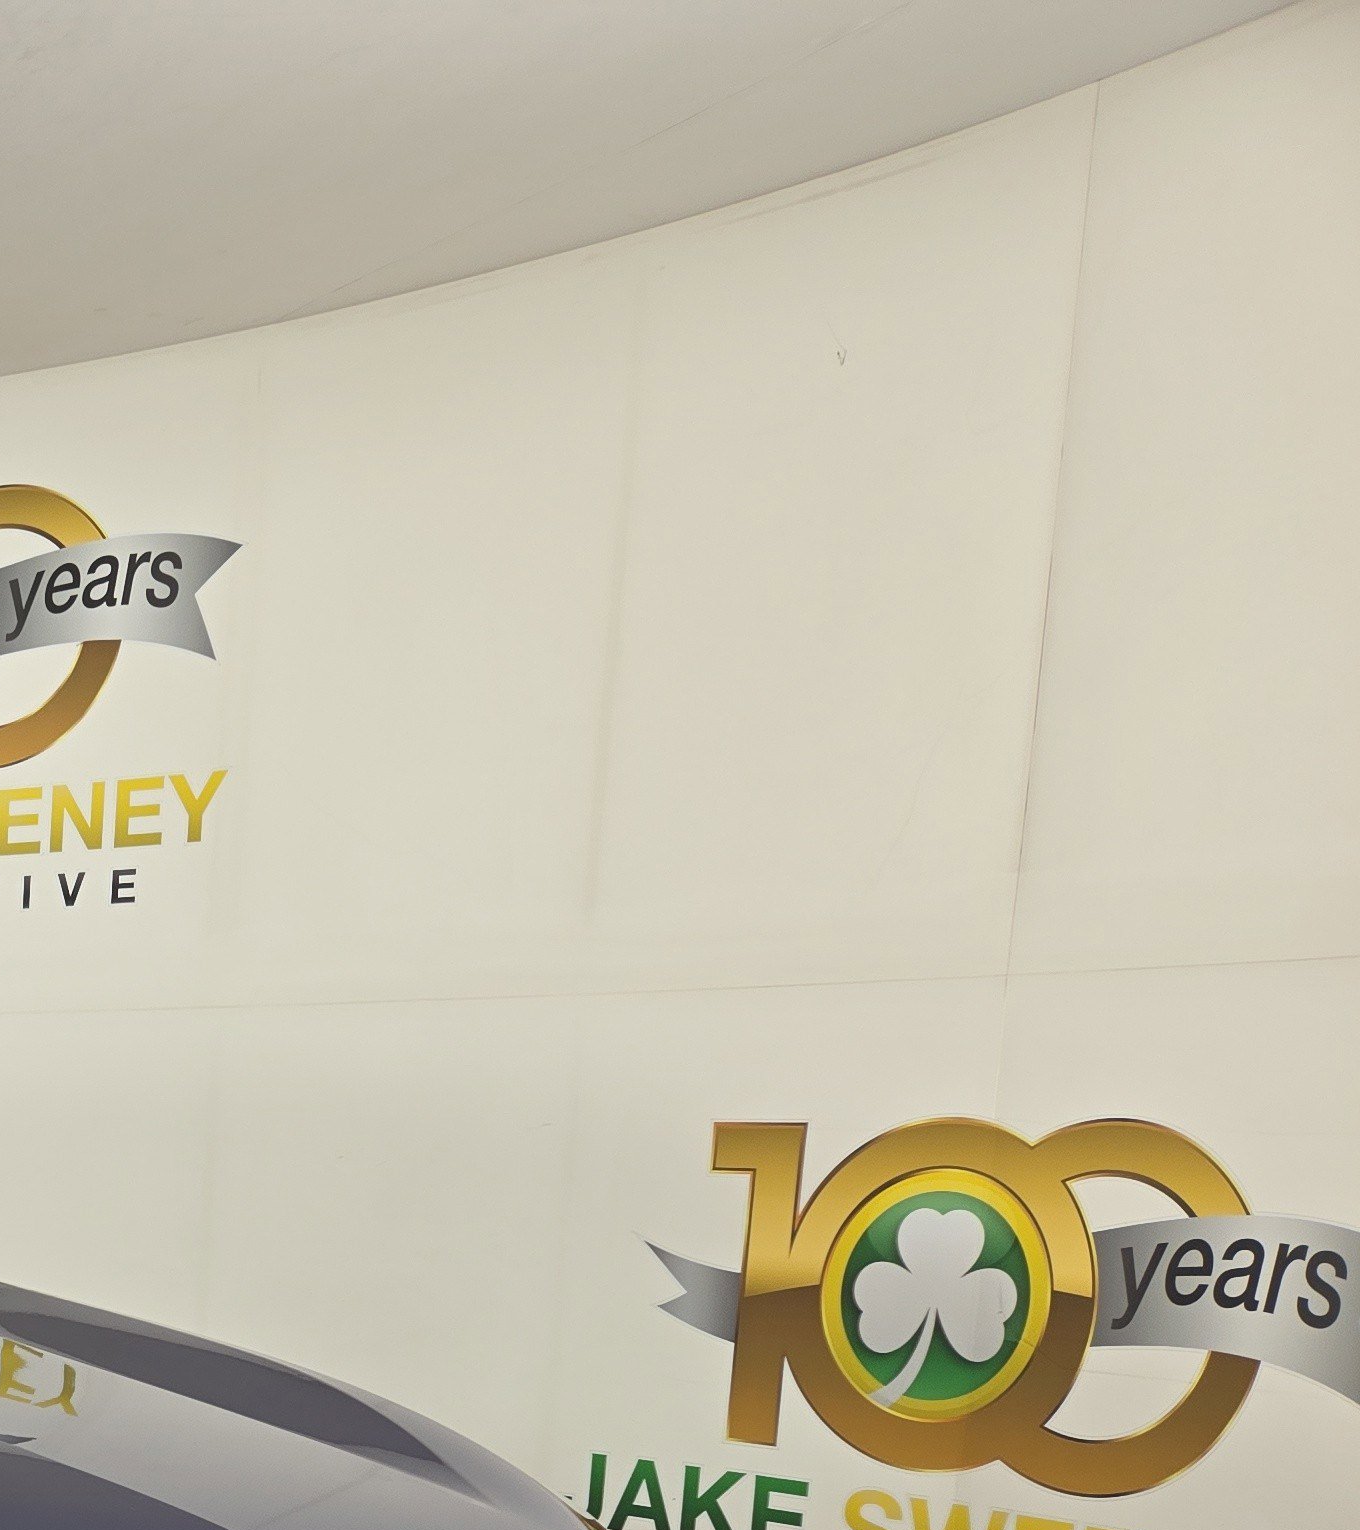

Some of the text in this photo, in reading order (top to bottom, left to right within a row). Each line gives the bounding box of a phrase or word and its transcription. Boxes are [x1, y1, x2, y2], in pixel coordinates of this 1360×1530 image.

[5, 549, 183, 643] years
[710, 1117, 1349, 1498] 100 years
